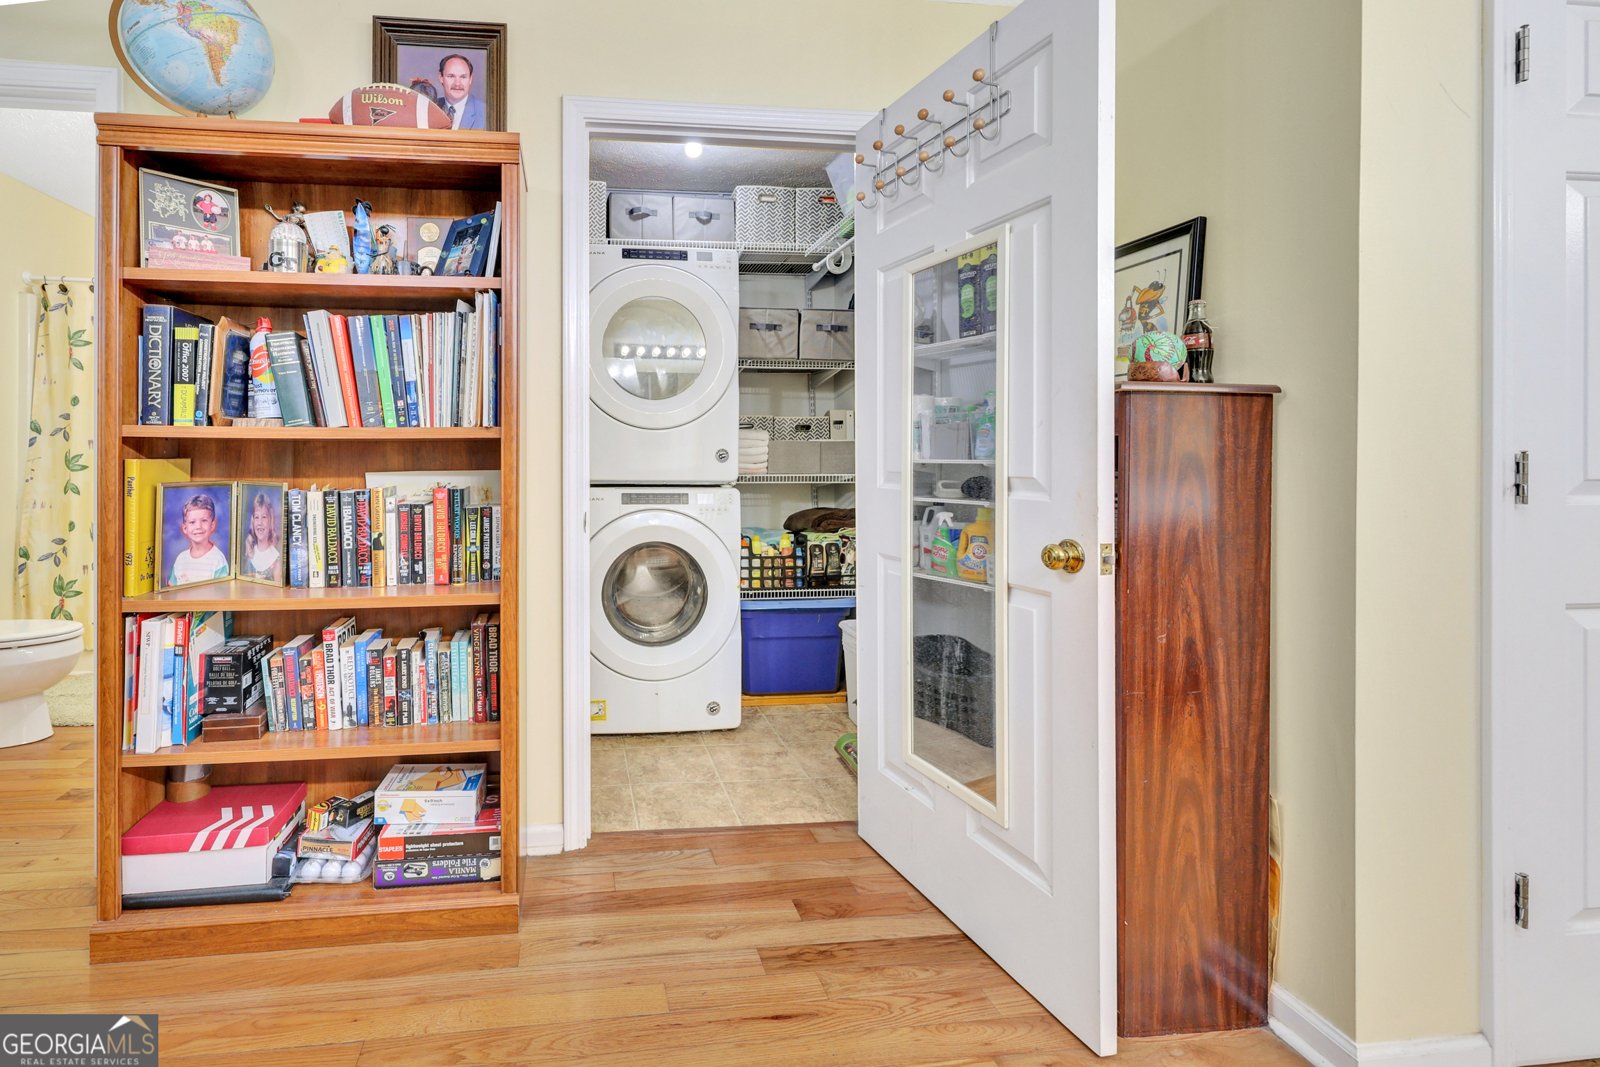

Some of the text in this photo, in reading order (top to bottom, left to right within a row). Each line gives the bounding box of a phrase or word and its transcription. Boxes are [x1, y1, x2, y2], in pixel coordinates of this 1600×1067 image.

[361, 93, 404, 106] Wilson
[147, 324, 162, 409] DICTIONARY
[181, 342, 190, 383] Office 2007
[291, 495, 302, 546] TOM CLANCY
[326, 503, 336, 529] DAVID
[374, 490, 382, 530] JOHN GRISHAM
[453, 491, 461, 514] STUART
[343, 509, 353, 549] BALDACCI
[356, 501, 369, 565] DAVID BALDACCI
[400, 511, 408, 558] MICHAEL CONNELLY
[414, 514, 422, 560] DAVID BALDACCI
[436, 498, 446, 552] DAVID BALDACCI
[125, 552, 133, 567] 1973
[327, 529, 338, 564] BALDACCI
[325, 643, 335, 685] BRAD THOR
[488, 626, 498, 672] BRAD THOR
[285, 655, 297, 698] DAVID BALDACCI
[315, 672, 326, 699] PATTERSON
[302, 845, 333, 854] PINNACLE
[432, 858, 477, 868] File Folders
[448, 866, 477, 876] MANILA
